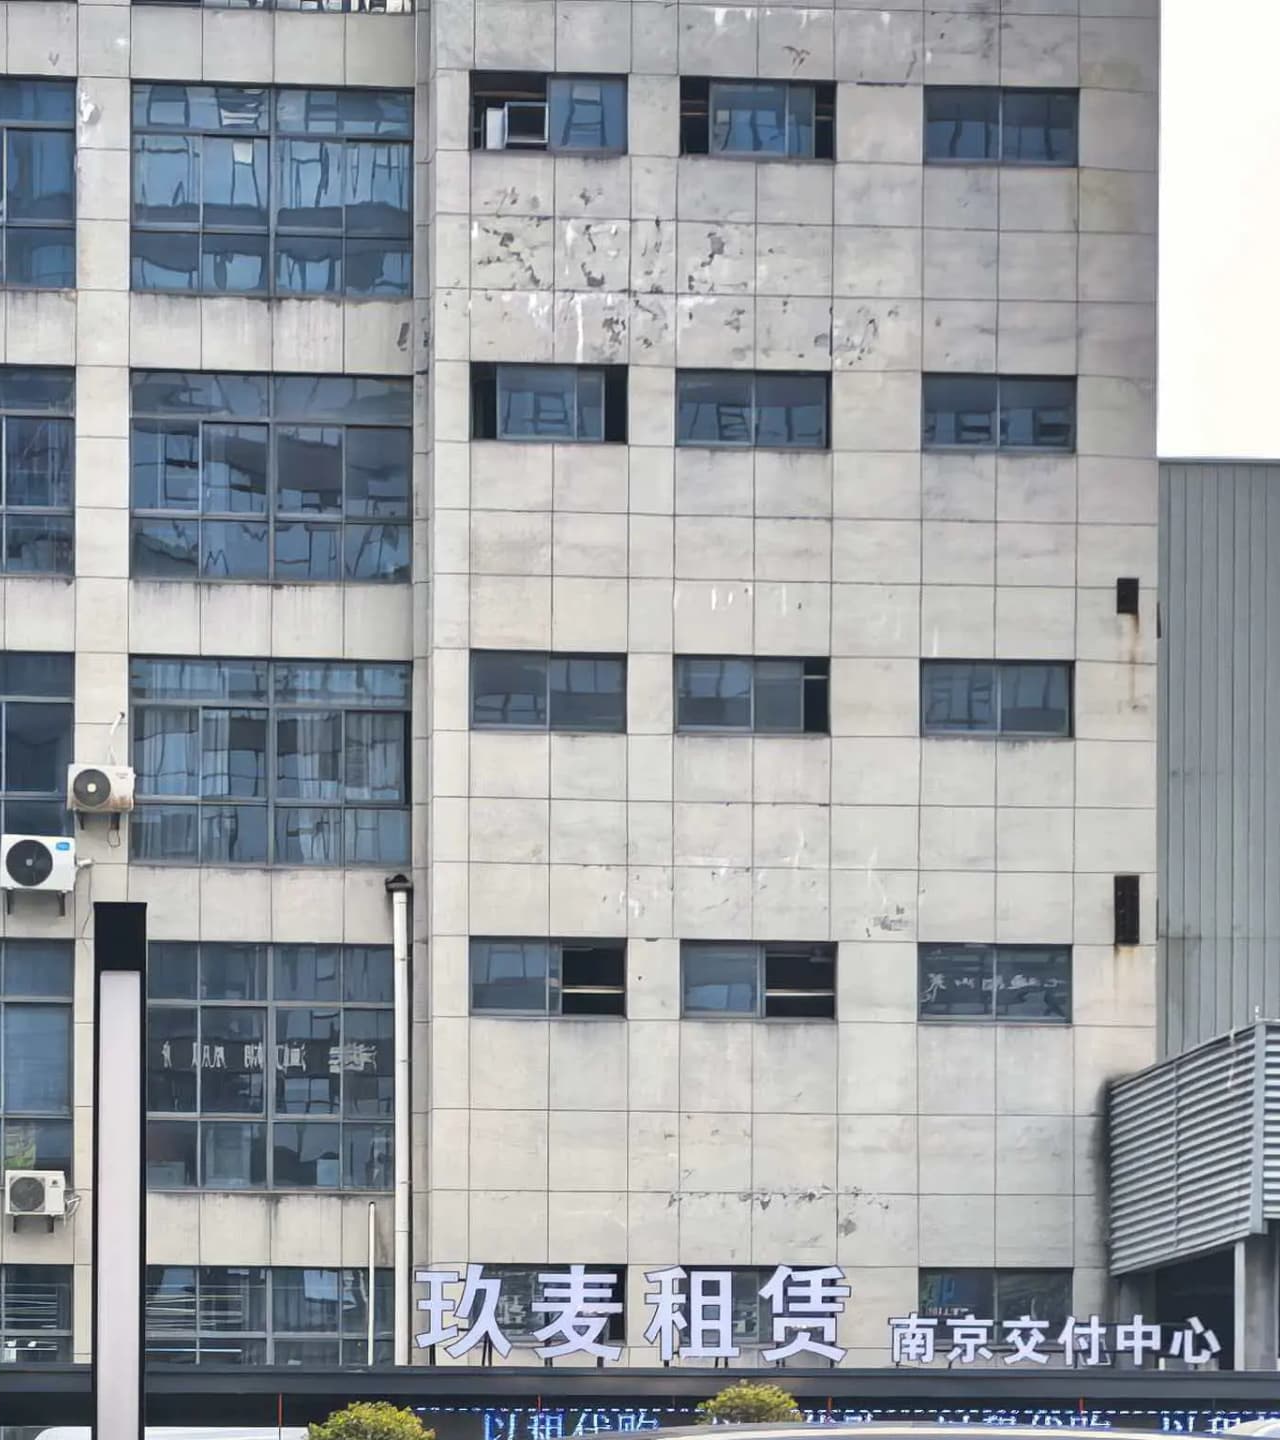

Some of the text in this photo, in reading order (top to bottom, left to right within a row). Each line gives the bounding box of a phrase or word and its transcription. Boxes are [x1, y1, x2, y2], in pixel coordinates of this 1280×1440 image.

[414, 1264, 1221, 1365] 玖麦租赁 南京交付中心
